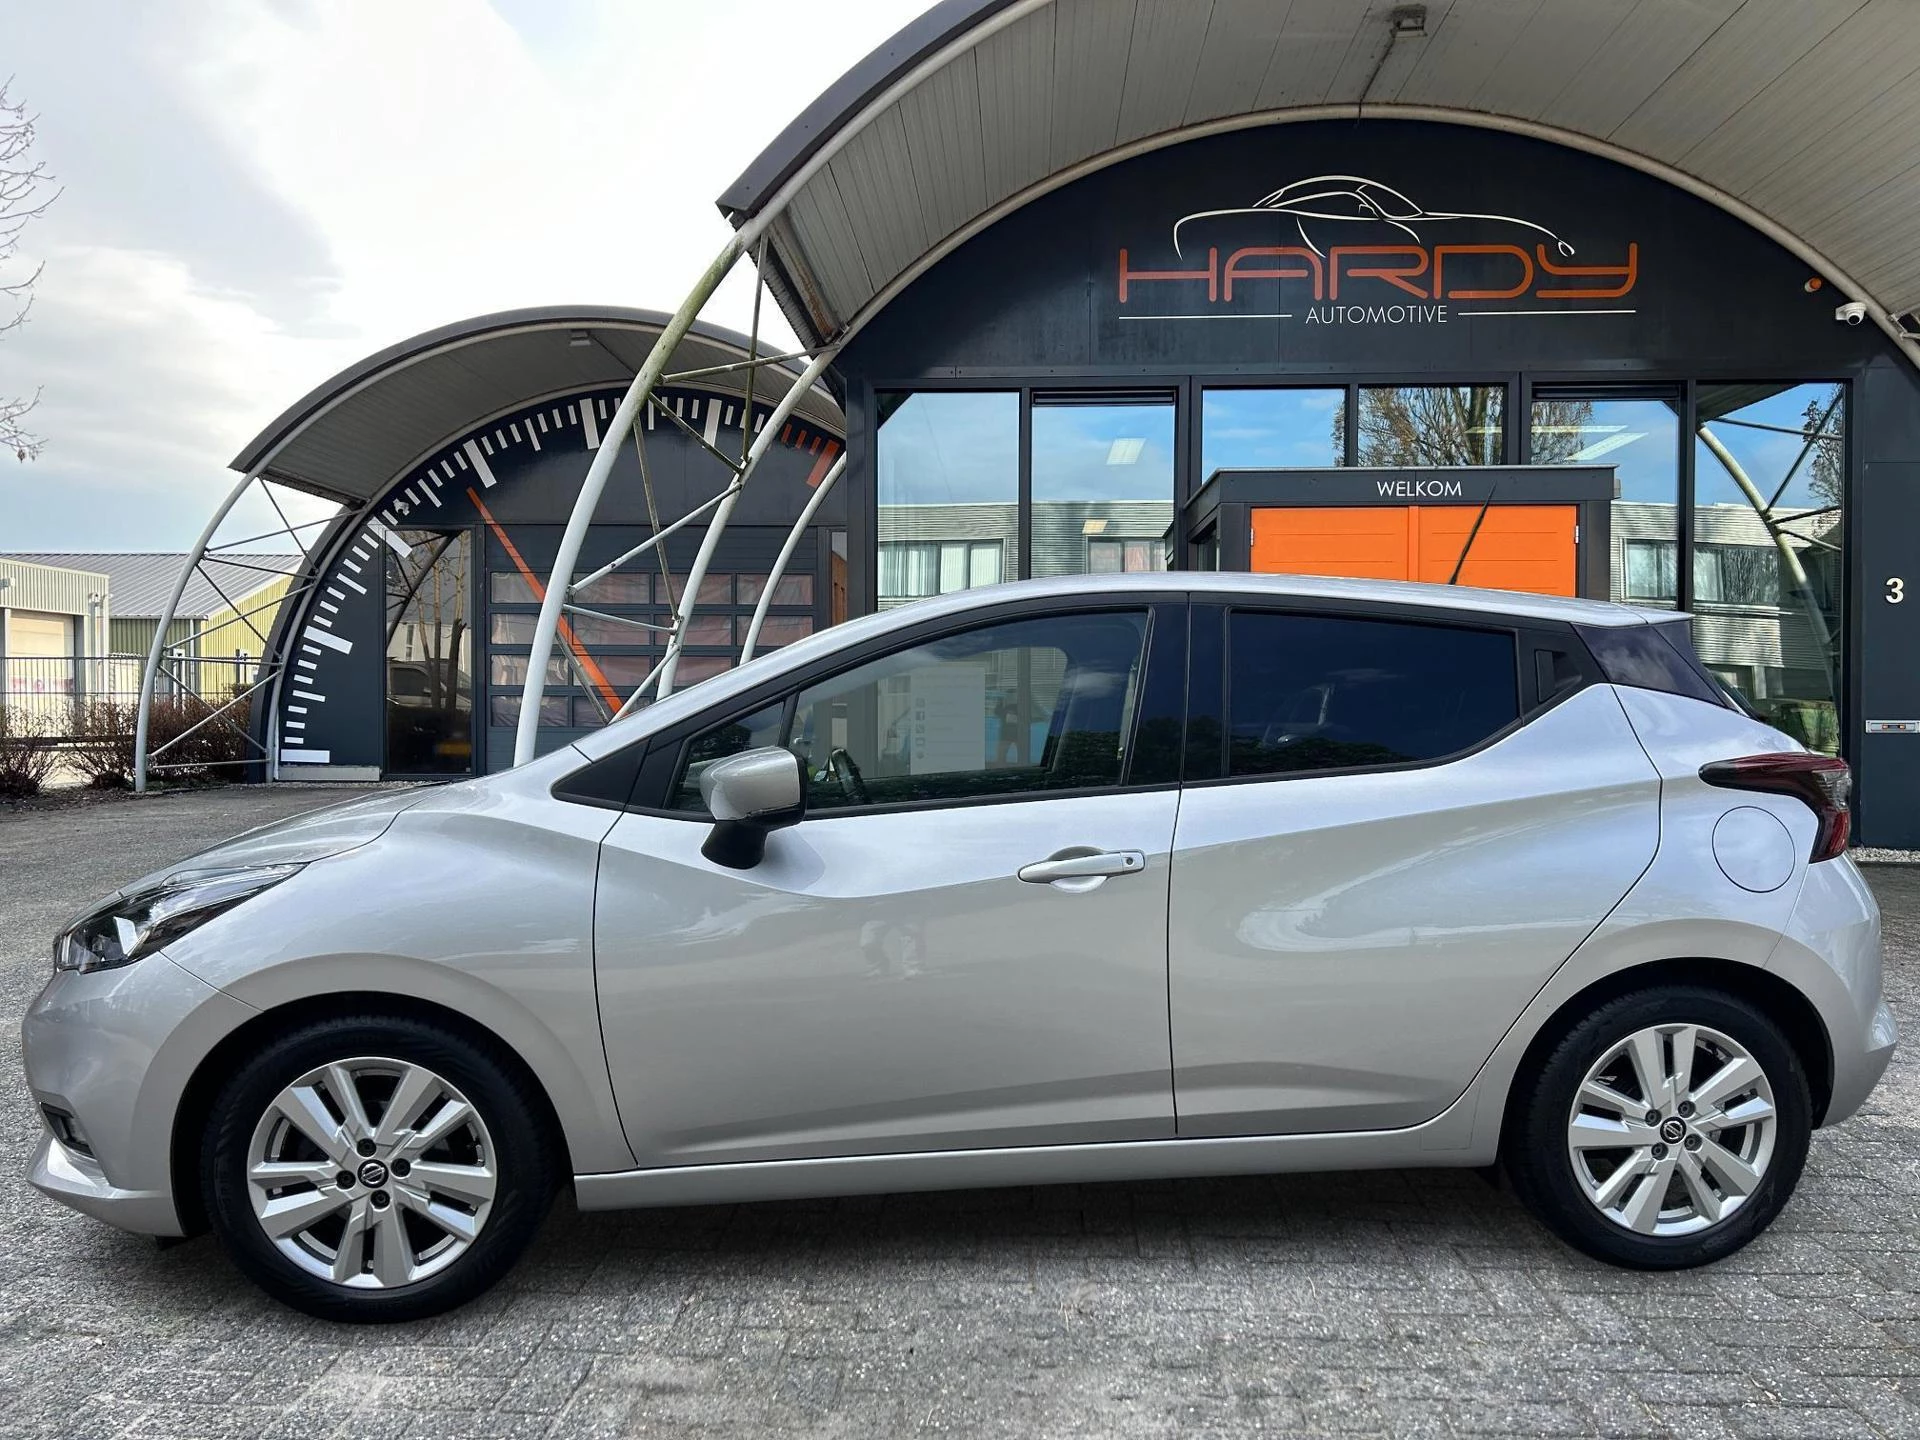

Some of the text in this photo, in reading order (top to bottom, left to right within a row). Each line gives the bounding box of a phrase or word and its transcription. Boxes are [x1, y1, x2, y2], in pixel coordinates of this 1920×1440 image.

[1119, 242, 1638, 301] HARDY
[1305, 305, 1448, 324] AUTOMOTIVE
[1376, 480, 1462, 497] WELKOM
[1885, 577, 1904, 604] 3
